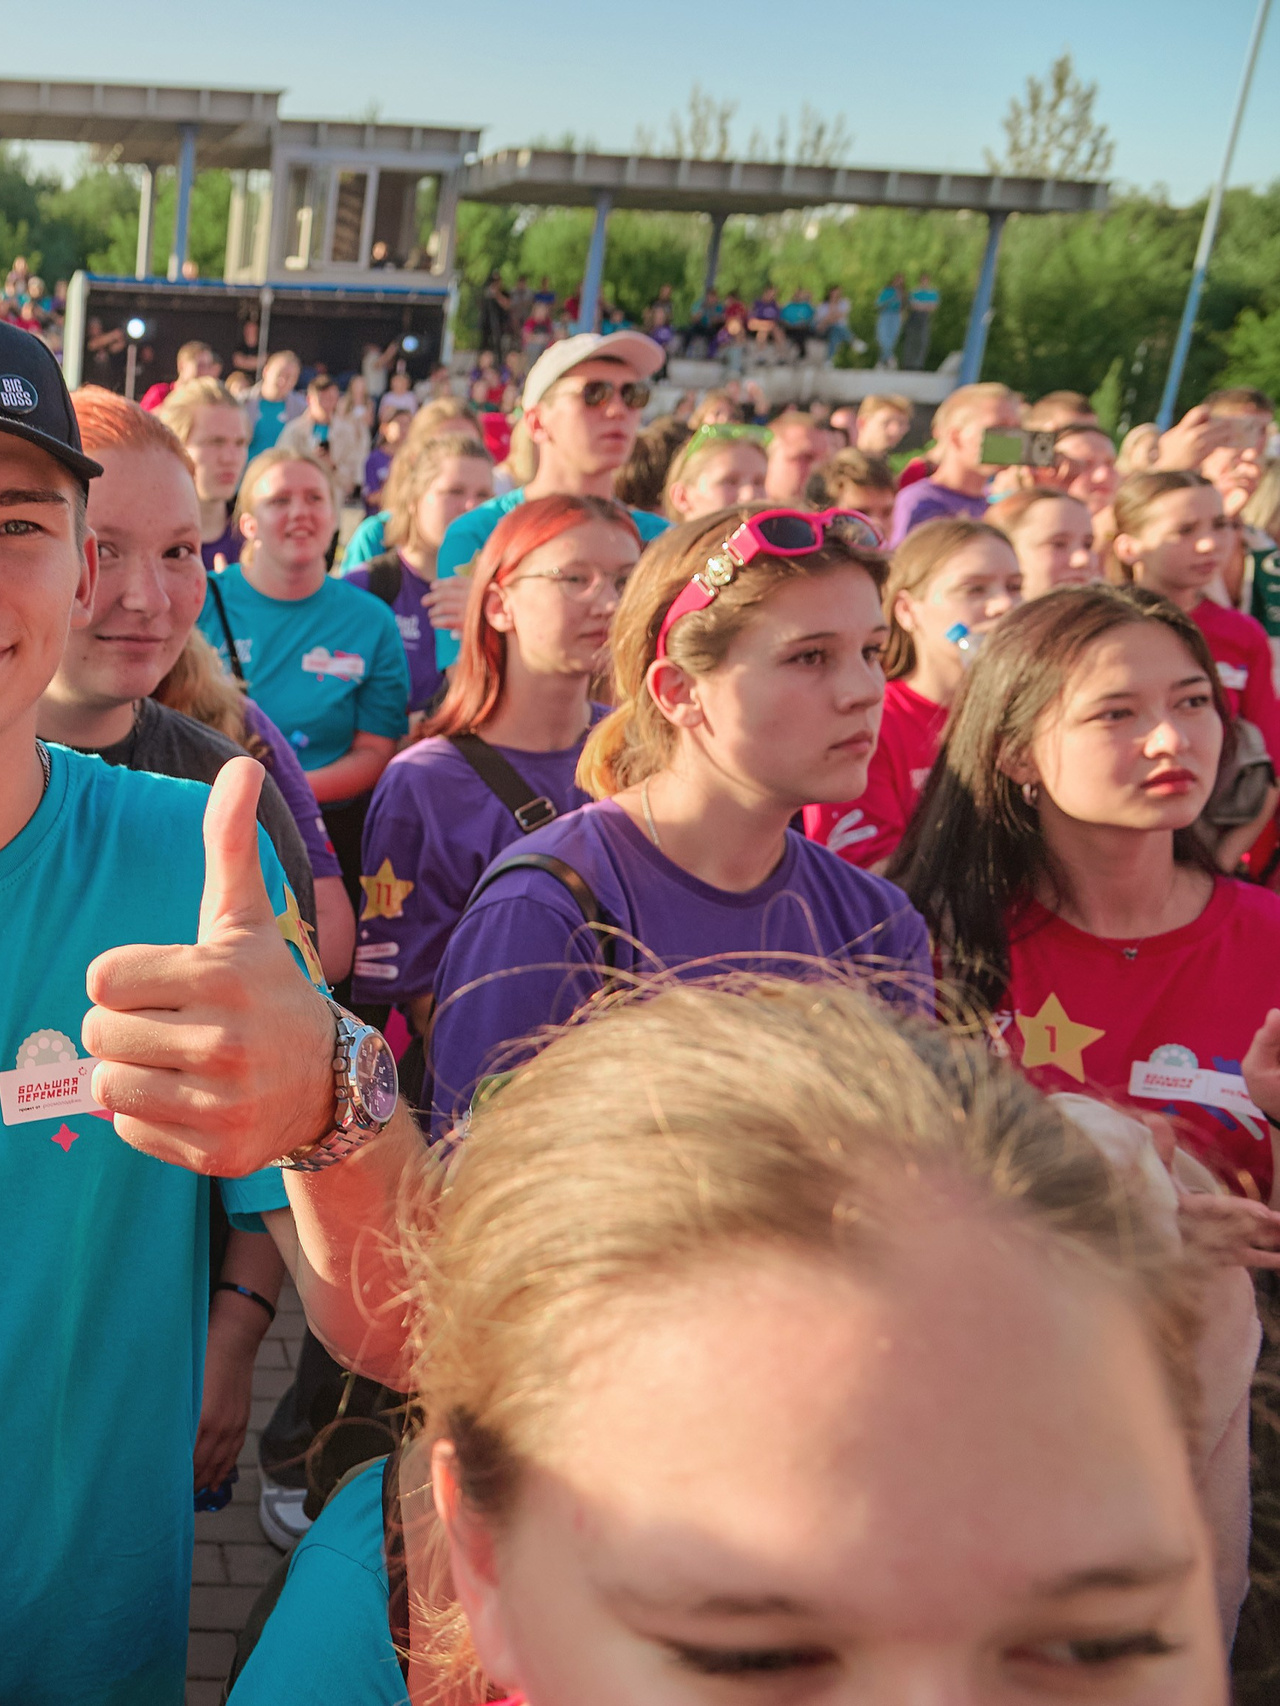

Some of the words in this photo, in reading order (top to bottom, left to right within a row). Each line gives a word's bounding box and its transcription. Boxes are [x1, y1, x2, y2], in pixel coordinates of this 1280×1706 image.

[2, 378, 23, 393] BIG
[0, 391, 33, 407] BOSS
[376, 882, 392, 907] 11
[1044, 1025, 1057, 1053] 1
[17, 1086, 78, 1104] ПЕРЕМЕНА
[18, 1077, 79, 1095] БОЛЬШАЯ
